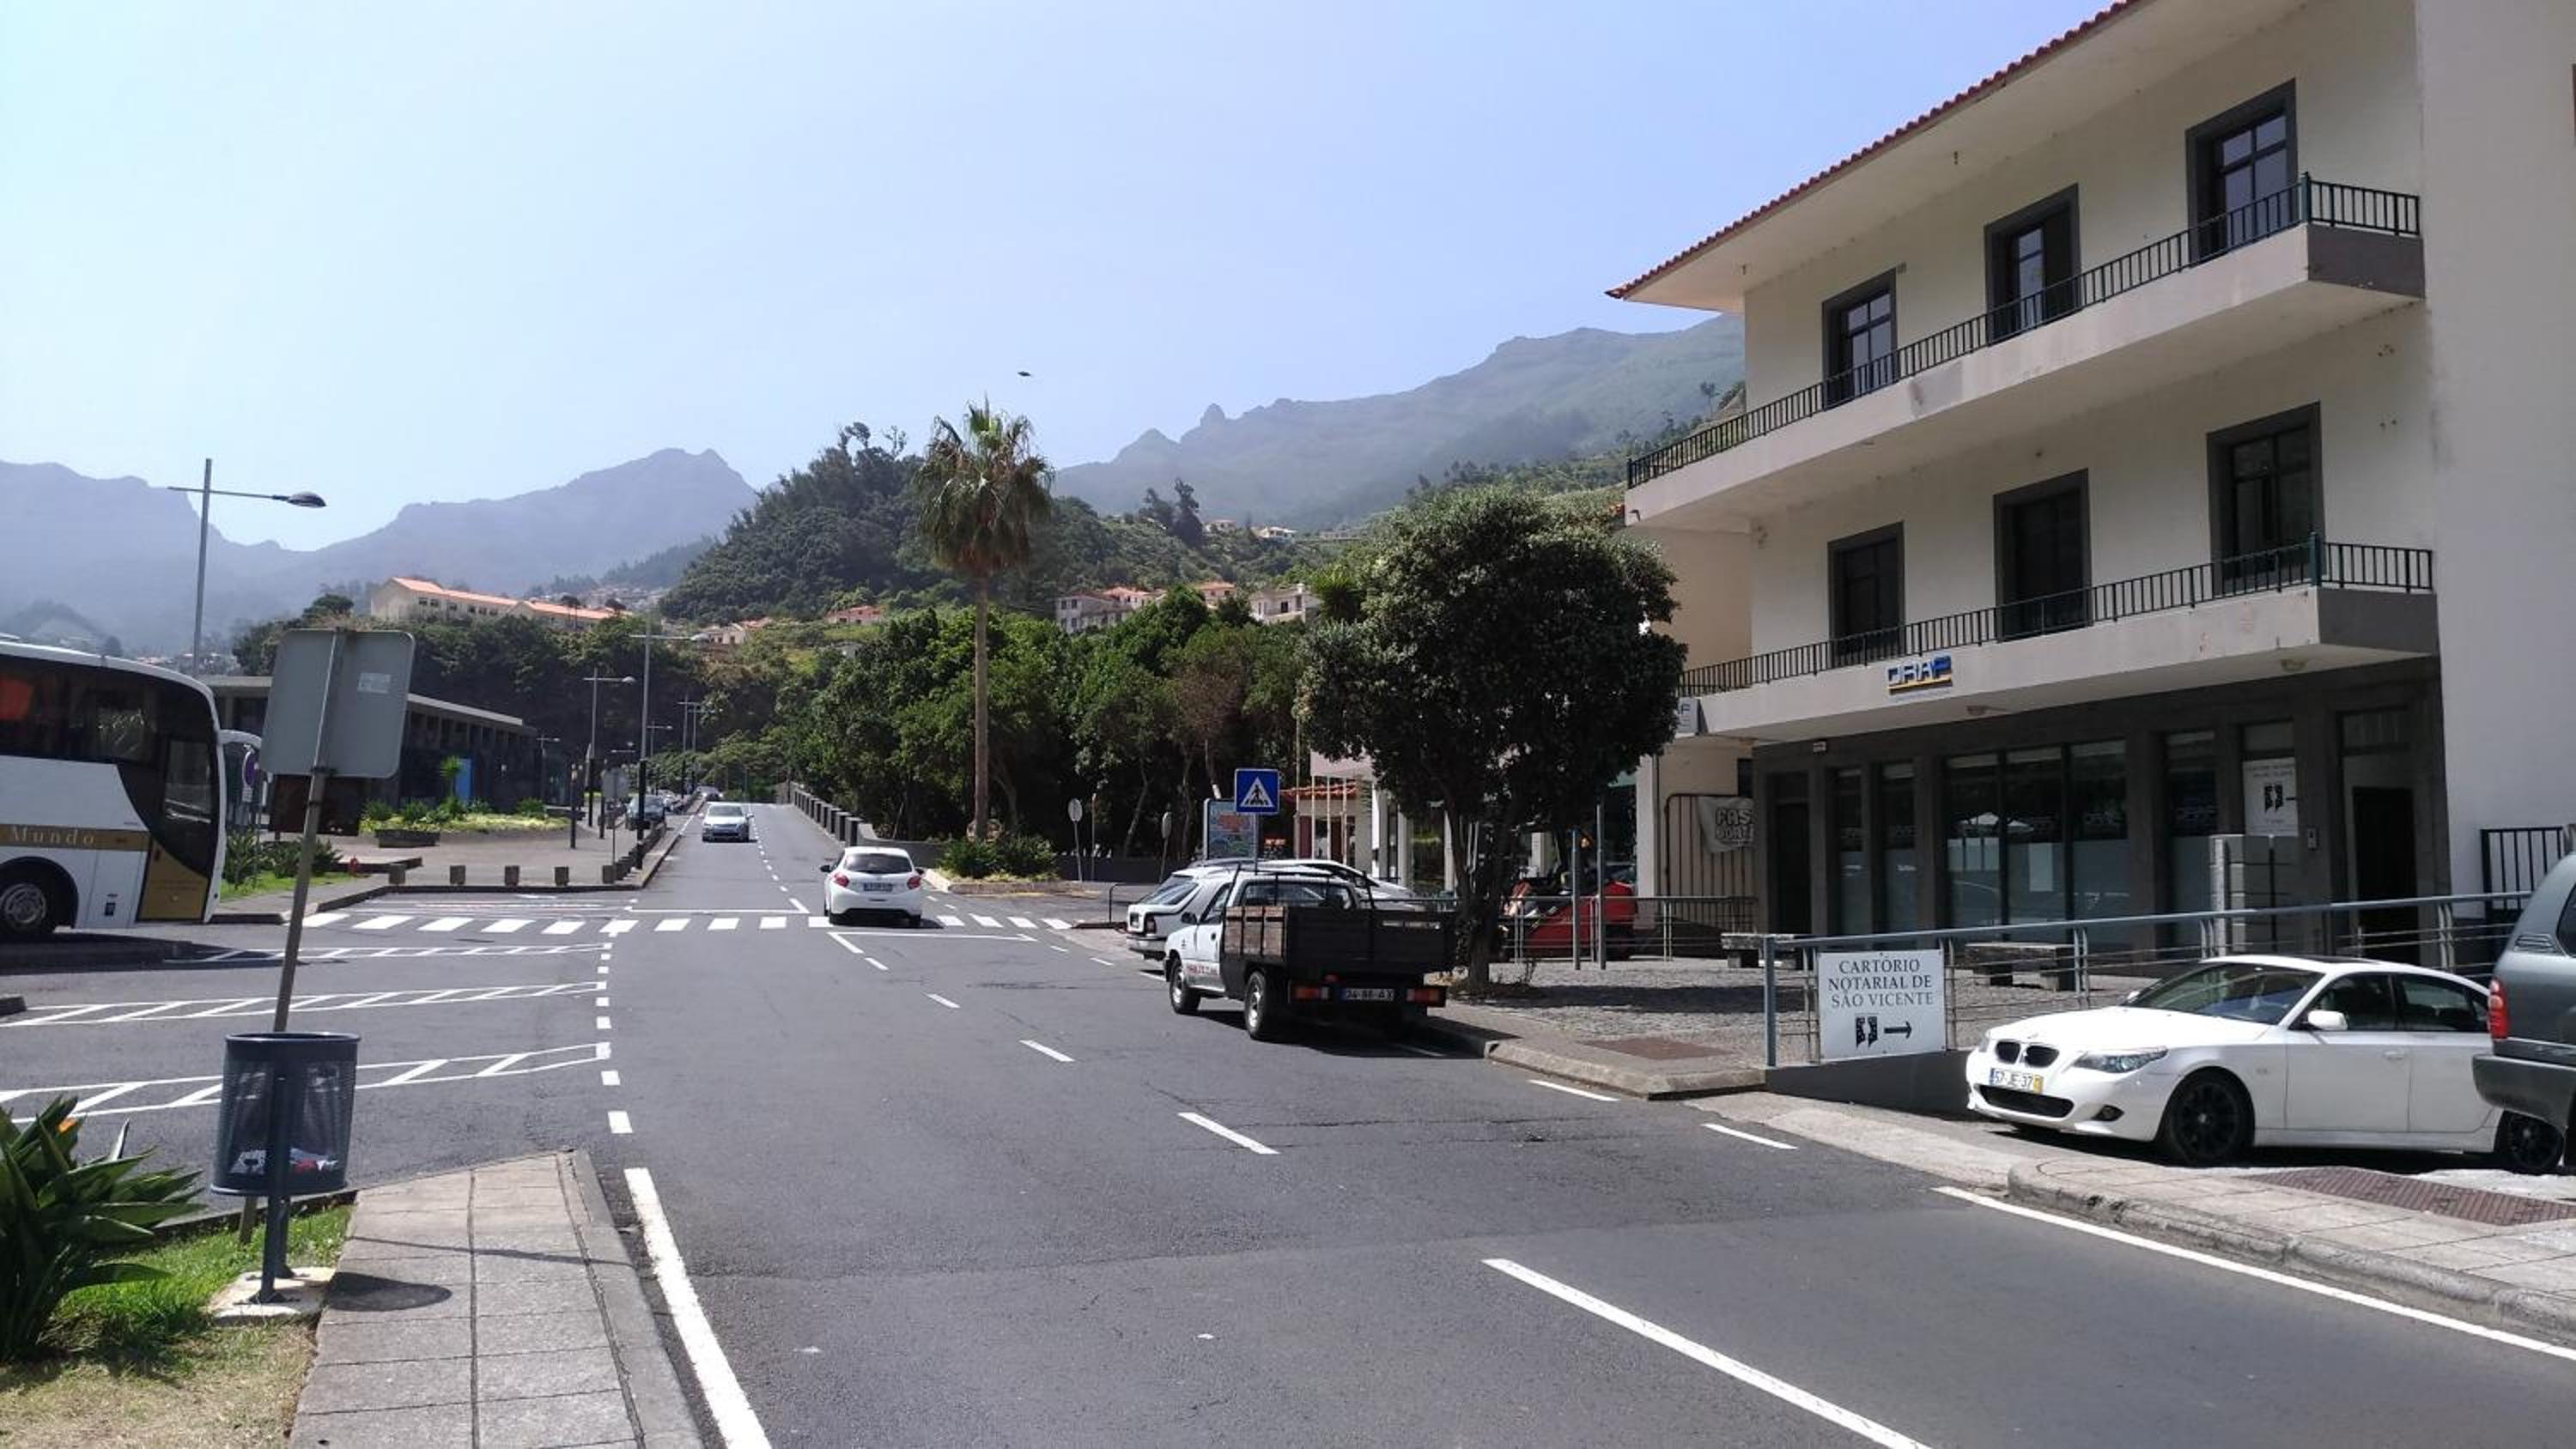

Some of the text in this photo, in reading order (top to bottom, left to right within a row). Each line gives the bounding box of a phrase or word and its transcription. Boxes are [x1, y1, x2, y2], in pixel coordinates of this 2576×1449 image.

[12, 826, 95, 846] Mundo
[1838, 956, 1921, 974] CARTÓRIO
[1828, 974, 1933, 991] NOTARIAL DE
[1831, 990, 1934, 1008] SÃO VICENTE
